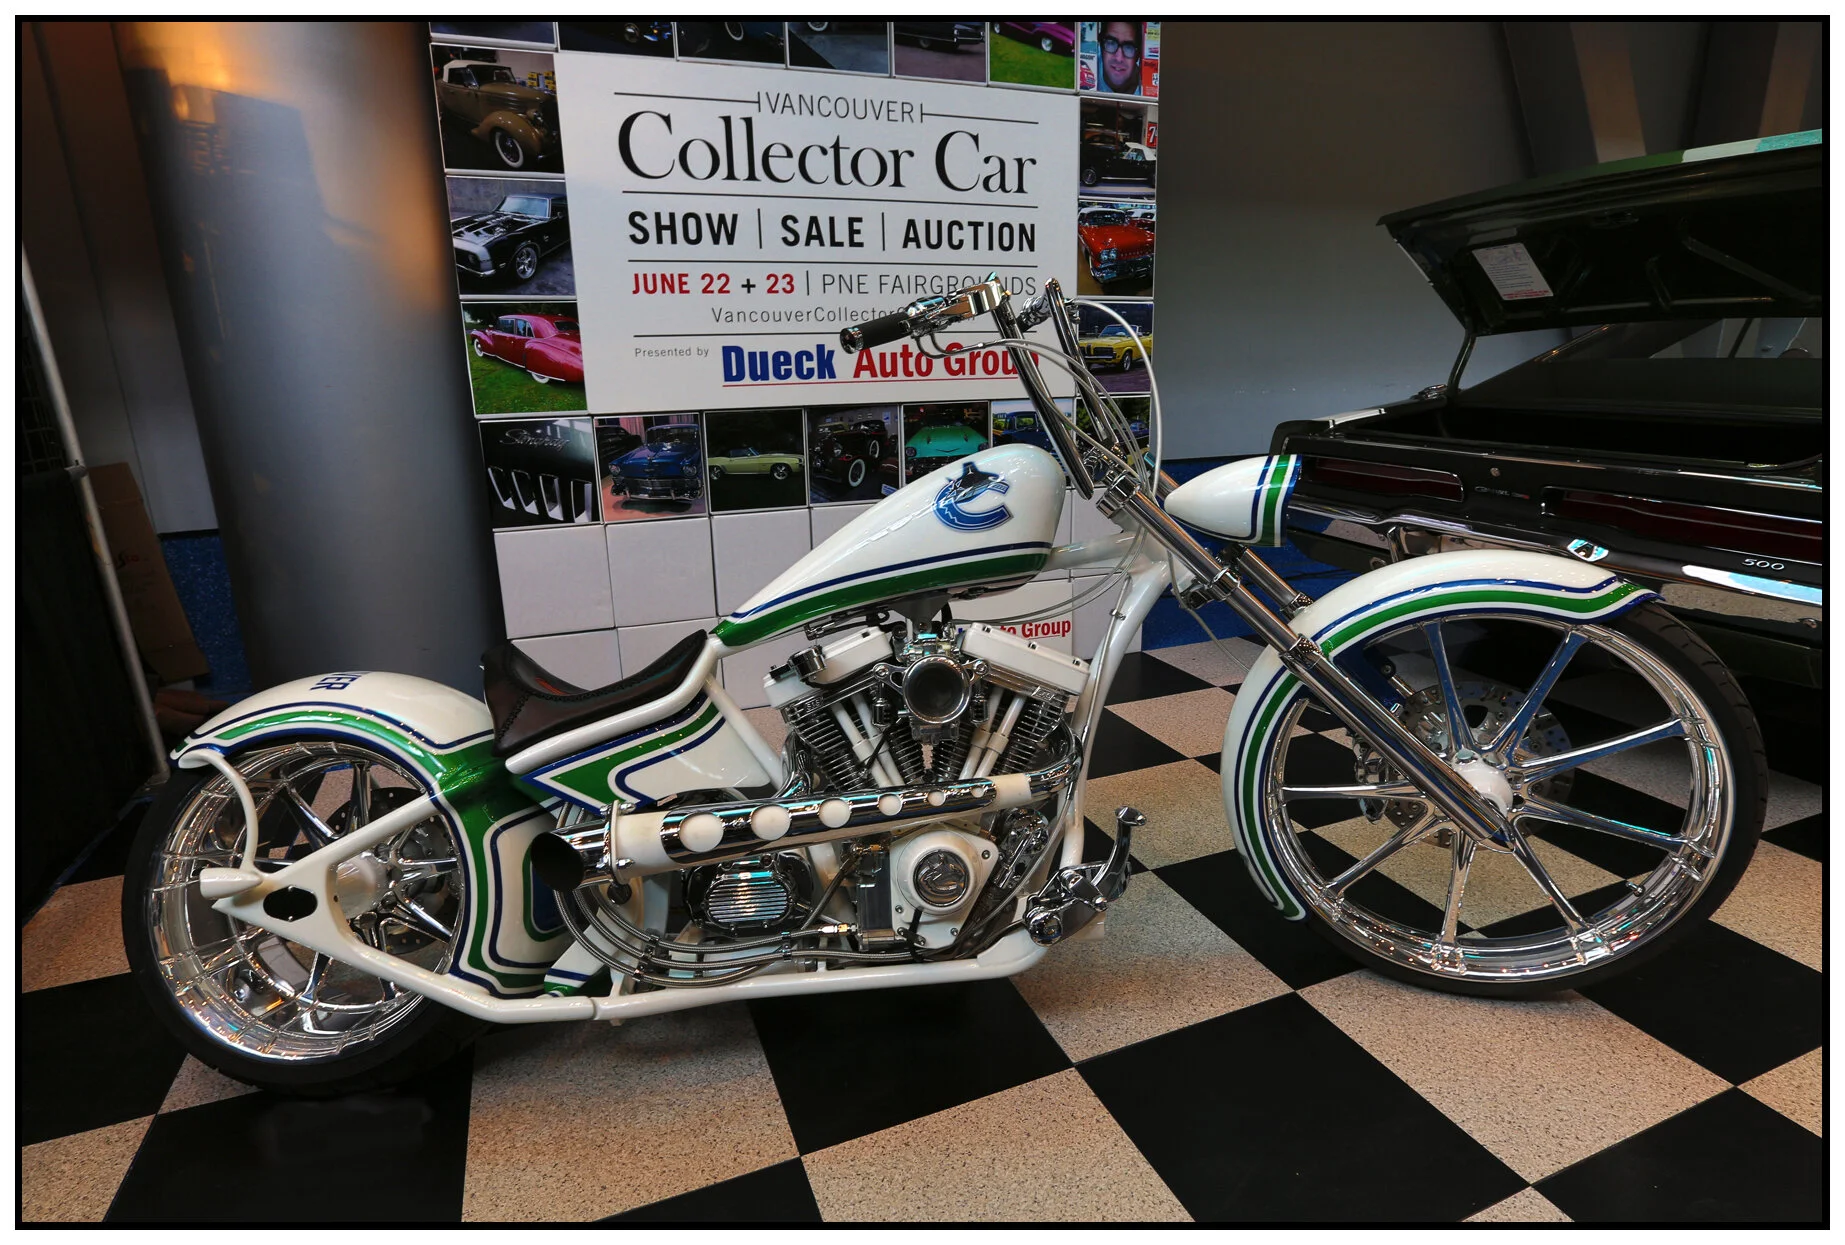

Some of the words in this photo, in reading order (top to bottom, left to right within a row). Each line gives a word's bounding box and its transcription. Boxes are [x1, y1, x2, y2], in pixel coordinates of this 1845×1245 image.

[764, 92, 915, 123] VANCOUVER
[618, 110, 915, 187] Collector
[934, 129, 1038, 194] Car
[628, 210, 739, 246] SHOW
[780, 214, 865, 248] SALE
[901, 217, 1037, 252] AUCTION
[631, 272, 691, 295] JUNE
[700, 272, 731, 294] 22
[766, 273, 795, 294] 23
[822, 274, 869, 294] PNE
[879, 274, 1037, 296] FAIRGRODS
[634, 346, 692, 358] Presented
[697, 347, 710, 358] by
[721, 343, 837, 382] Dueck
[853, 343, 933, 378] Auto
[1742, 558, 1785, 571] 500
[1021, 620, 1071, 638] Group
